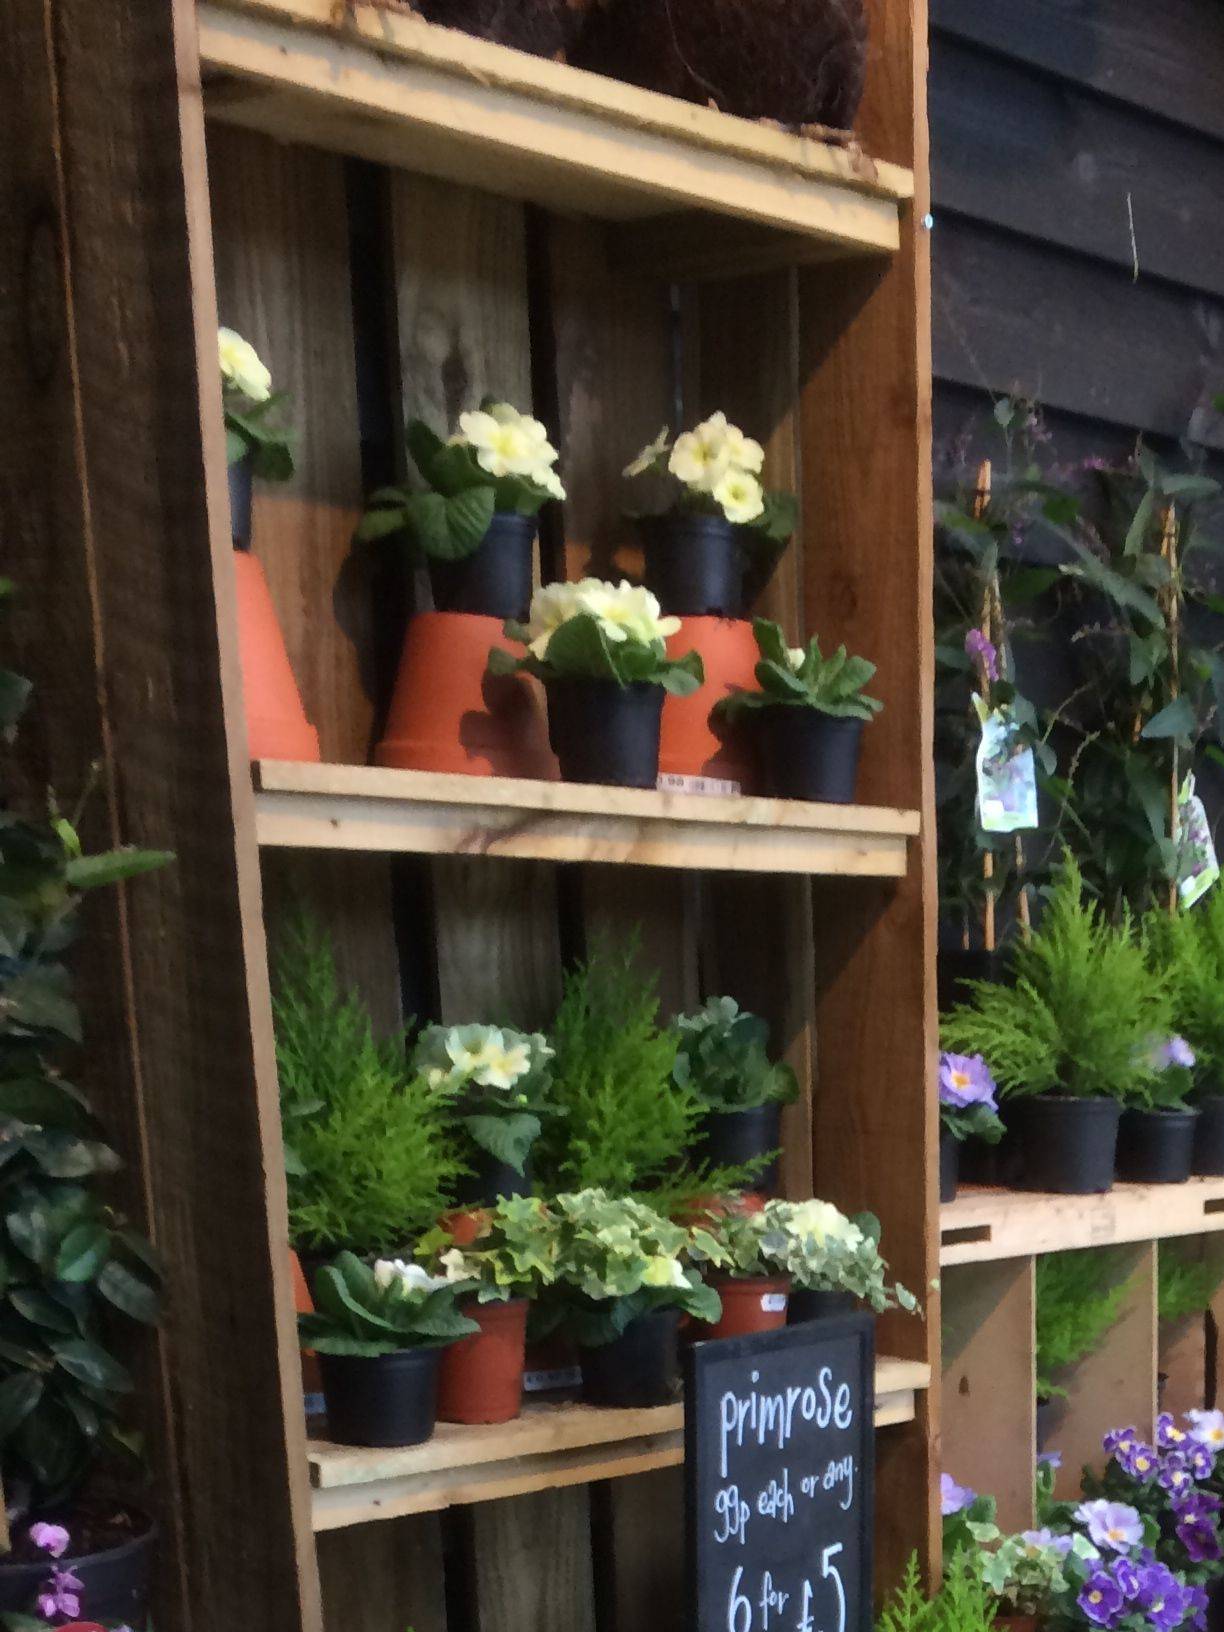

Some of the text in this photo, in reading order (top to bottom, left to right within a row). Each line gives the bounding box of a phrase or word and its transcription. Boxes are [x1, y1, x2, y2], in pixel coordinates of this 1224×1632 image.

[758, 1468, 794, 1524] each
[801, 1475, 820, 1498] or
[760, 1570, 790, 1631] for
